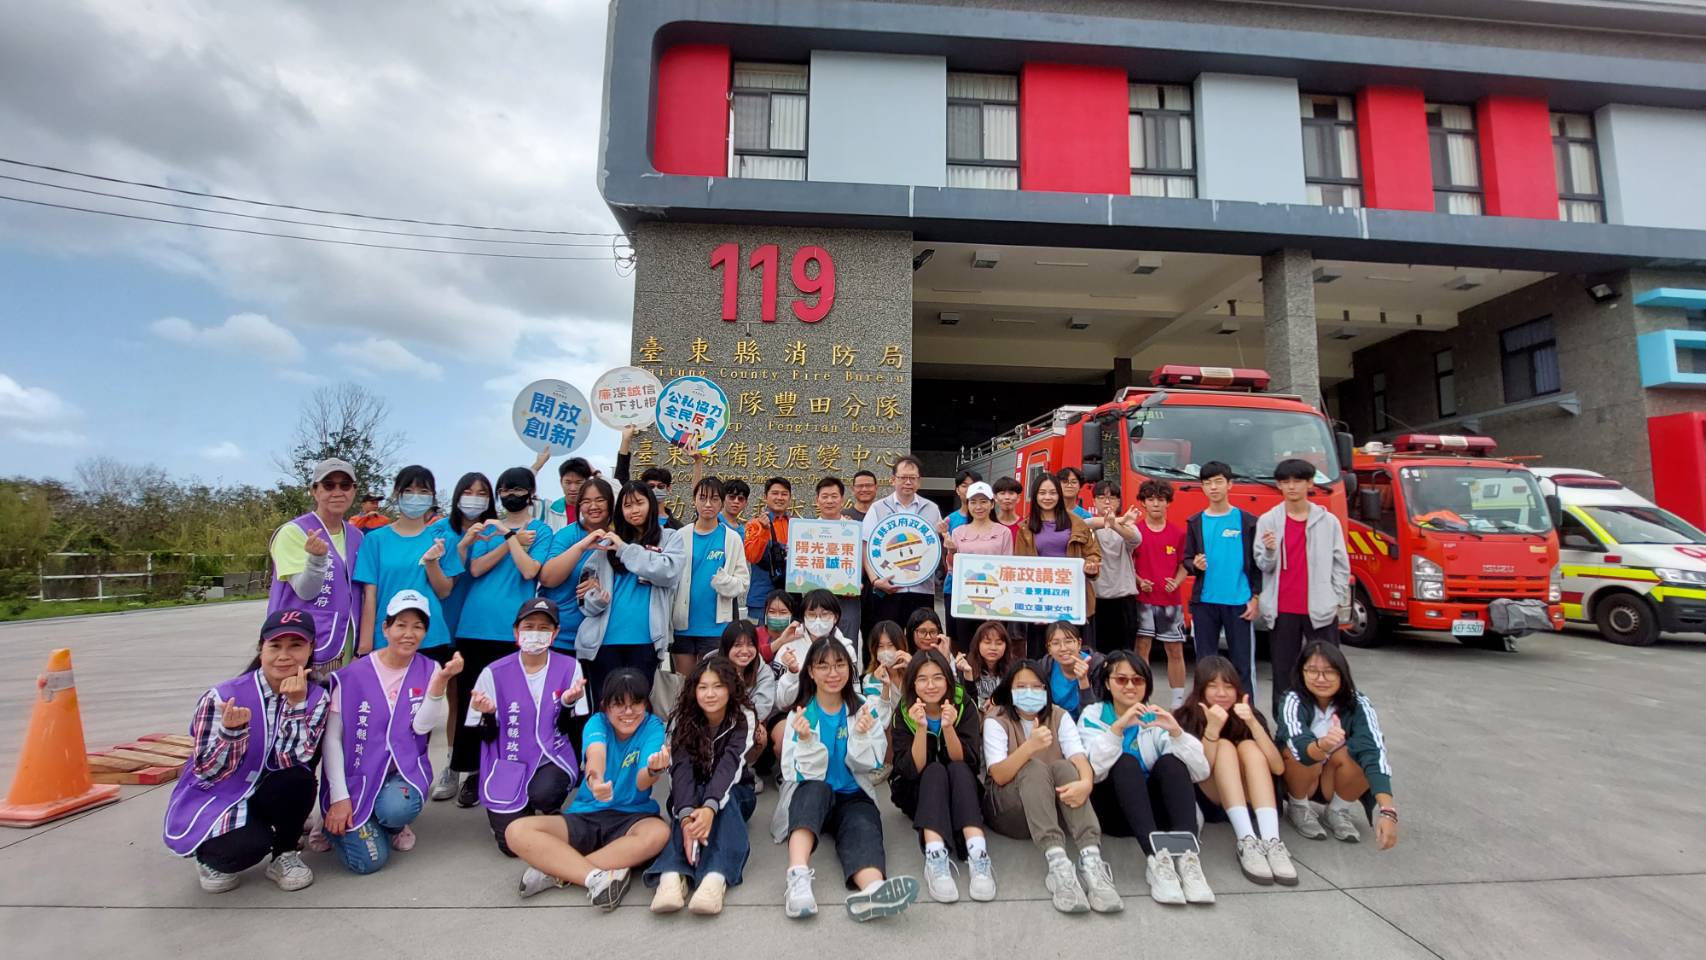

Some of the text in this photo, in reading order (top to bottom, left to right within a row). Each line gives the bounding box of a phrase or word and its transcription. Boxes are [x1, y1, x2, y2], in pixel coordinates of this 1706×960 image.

[709, 242, 836, 323] 119
[639, 336, 903, 369] 臺東縣消防局
[720, 367, 779, 381] County
[792, 370, 831, 381] Fire
[598, 385, 655, 401] 廉潔誠信
[529, 392, 582, 427] 開放
[599, 397, 656, 414] 向下扎根
[668, 391, 723, 418] 公私協力
[664, 405, 718, 430] 全民反貪
[768, 421, 838, 433] Fengtian
[851, 421, 903, 434] Branch
[522, 416, 577, 449] 創新
[795, 540, 855, 555] 陽光臺東
[795, 555, 855, 569] 幸福誠市
[314, 551, 335, 608] 東縣政府
[1000, 566, 1072, 584] 廉政講堂
